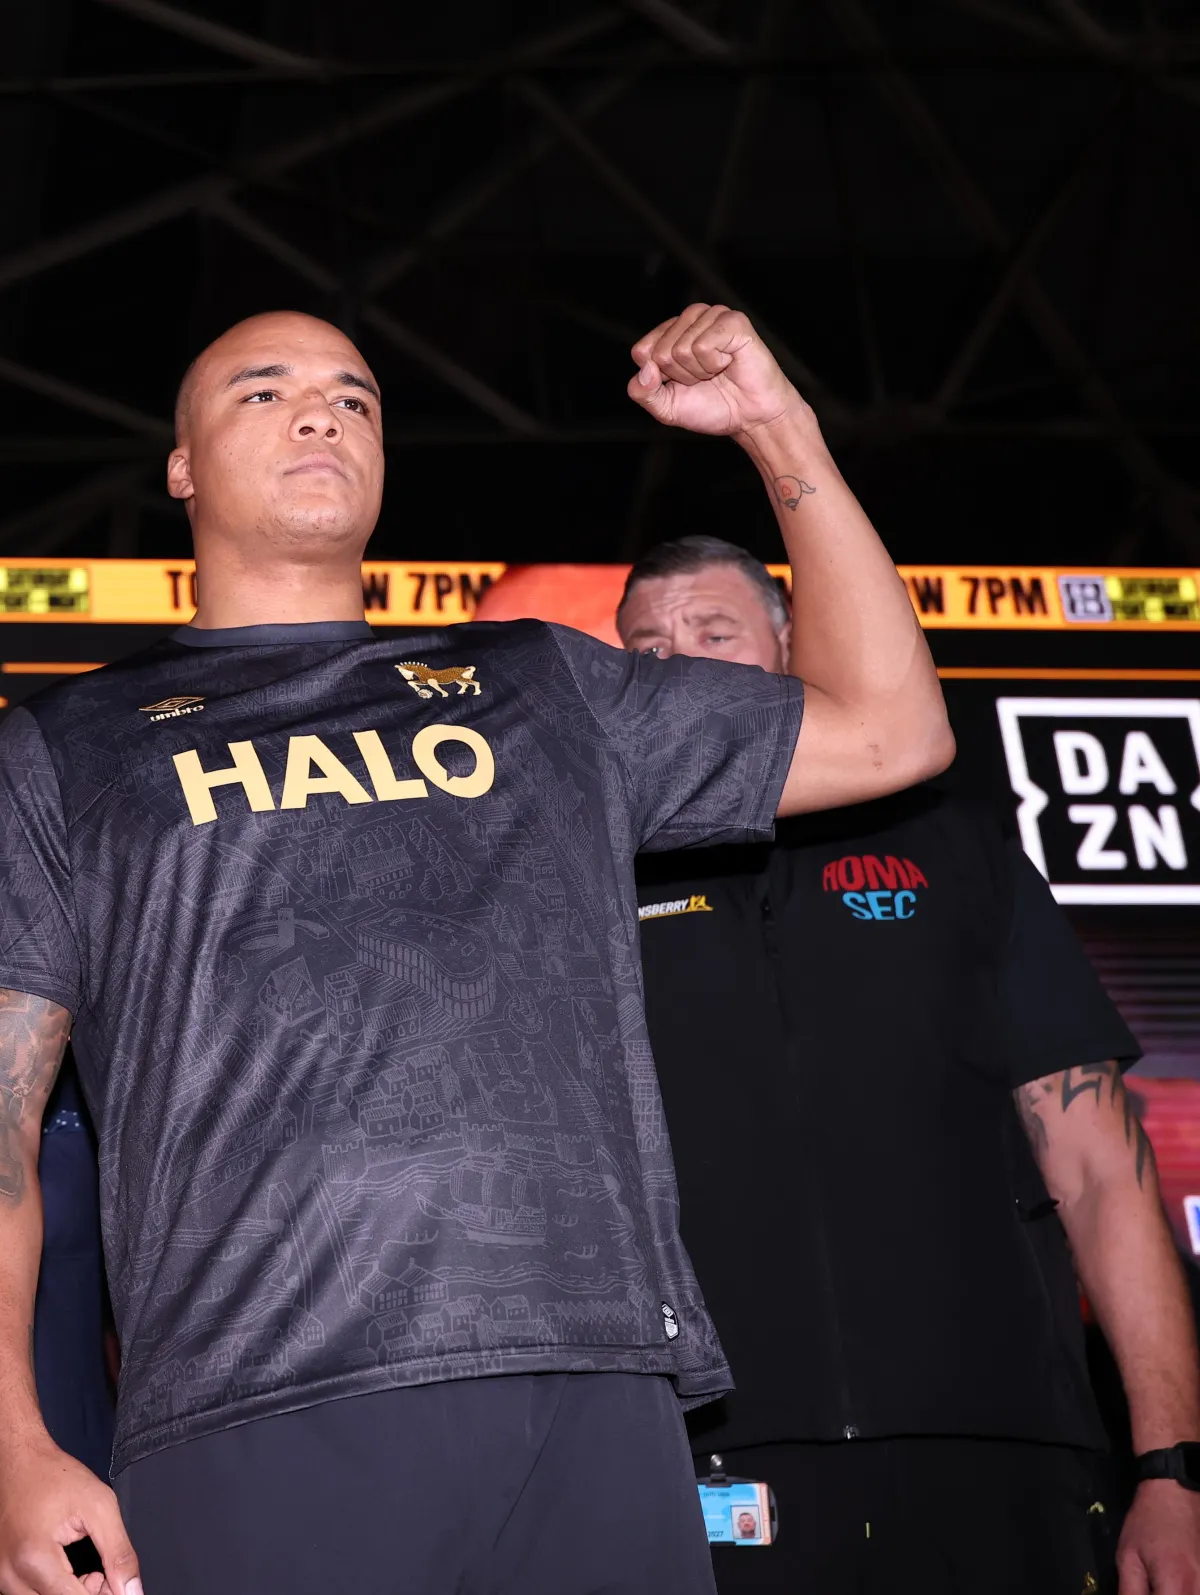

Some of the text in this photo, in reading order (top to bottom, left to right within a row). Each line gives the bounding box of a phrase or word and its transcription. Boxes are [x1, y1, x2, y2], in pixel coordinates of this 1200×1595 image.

[959, 576, 1049, 616] 7PM
[150, 705, 204, 722] umbro
[172, 723, 496, 826] HALO
[1052, 729, 1178, 796] DA
[1067, 803, 1189, 871] ZN
[842, 890, 917, 921] SEC
